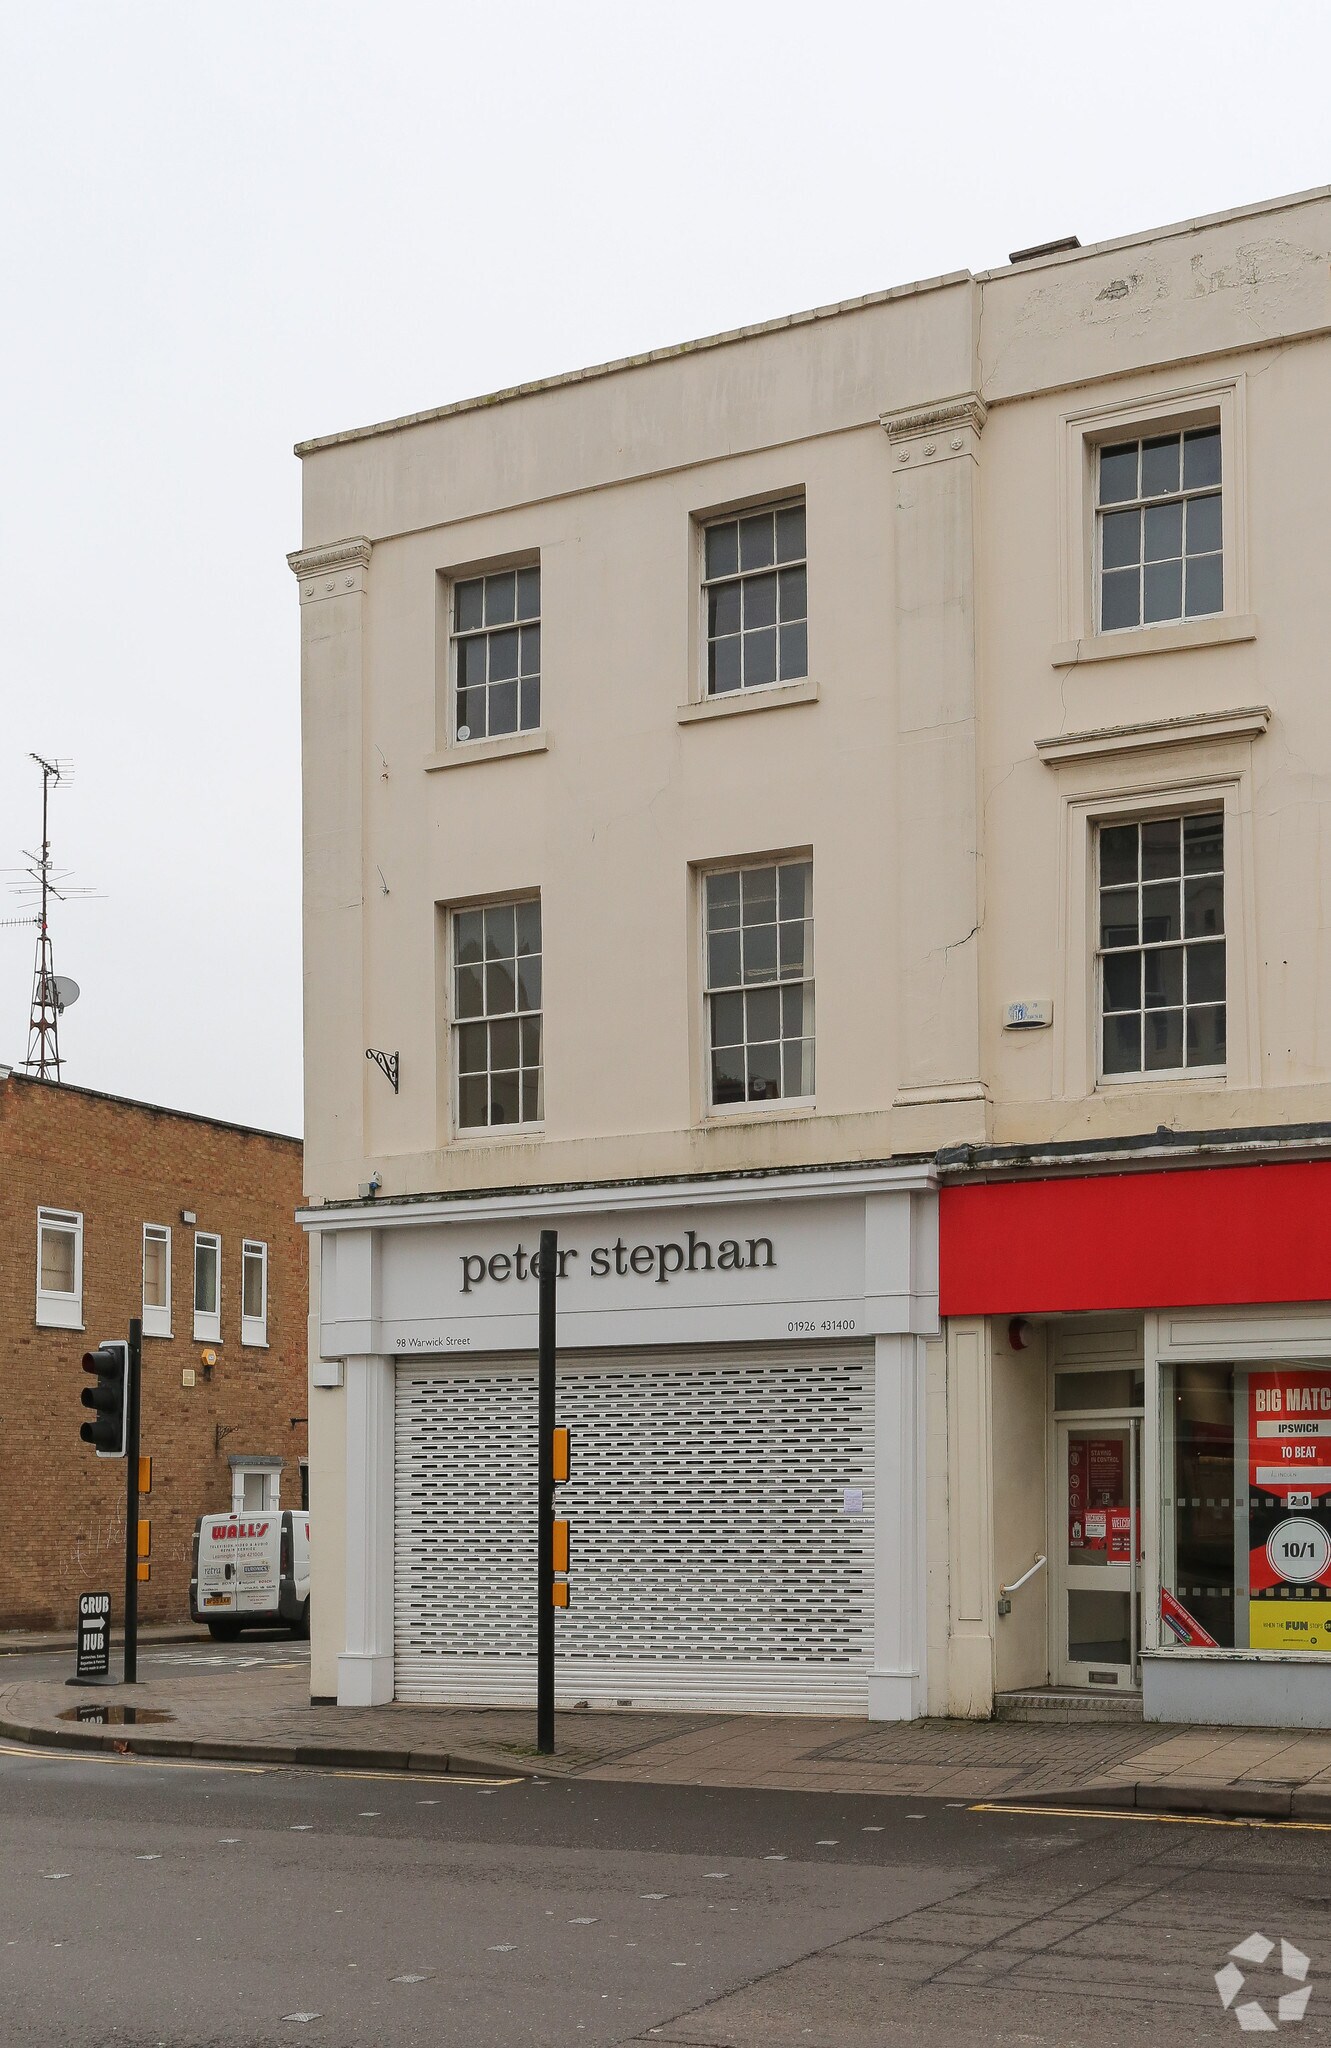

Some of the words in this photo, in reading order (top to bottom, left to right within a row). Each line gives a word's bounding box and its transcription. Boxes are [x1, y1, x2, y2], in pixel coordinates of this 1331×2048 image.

[591, 1230, 776, 1282] stephan
[788, 1321, 815, 1331] 01926
[821, 1320, 855, 1330] 431400
[396, 1338, 406, 1347] 98
[409, 1337, 443, 1346] Warwick
[446, 1336, 470, 1345] Street
[1256, 1389, 1281, 1412] BIG
[1278, 1423, 1319, 1433] IPSWICH
[1281, 1447, 1292, 1458] TO
[1295, 1446, 1316, 1458] BEAT
[212, 1523, 269, 1540] WALL'S
[1282, 1542, 1314, 1557] 10/1
[81, 1596, 109, 1614] GRUB
[1286, 1621, 1308, 1630] FUN
[83, 1633, 104, 1650] HUB
